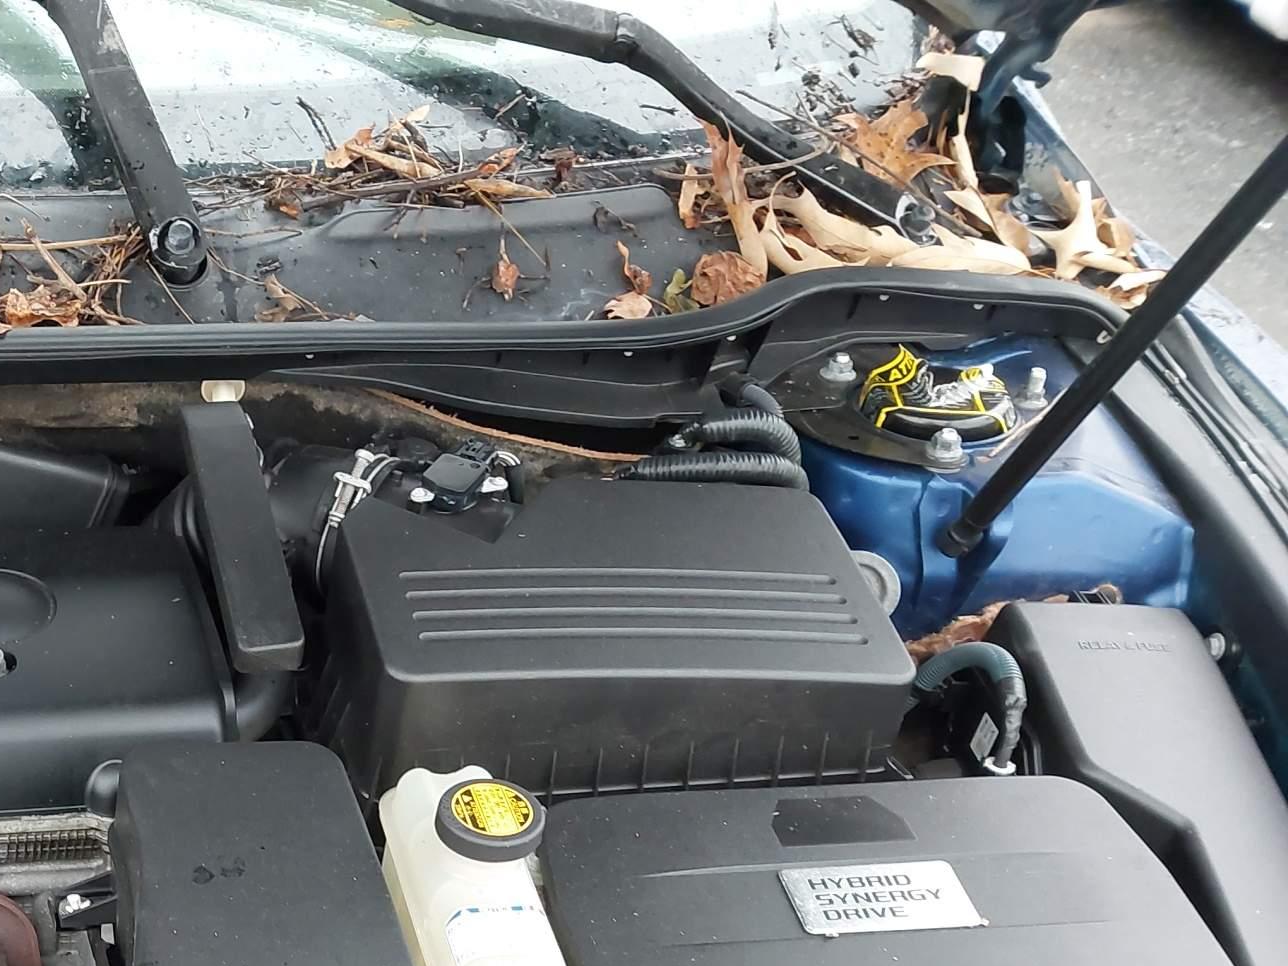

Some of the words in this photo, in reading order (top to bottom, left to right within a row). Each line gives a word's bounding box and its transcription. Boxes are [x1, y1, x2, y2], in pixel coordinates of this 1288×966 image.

[807, 874, 912, 890] HYBRID
[814, 887, 943, 906] SYNERGY
[822, 906, 909, 921] DRIVE
